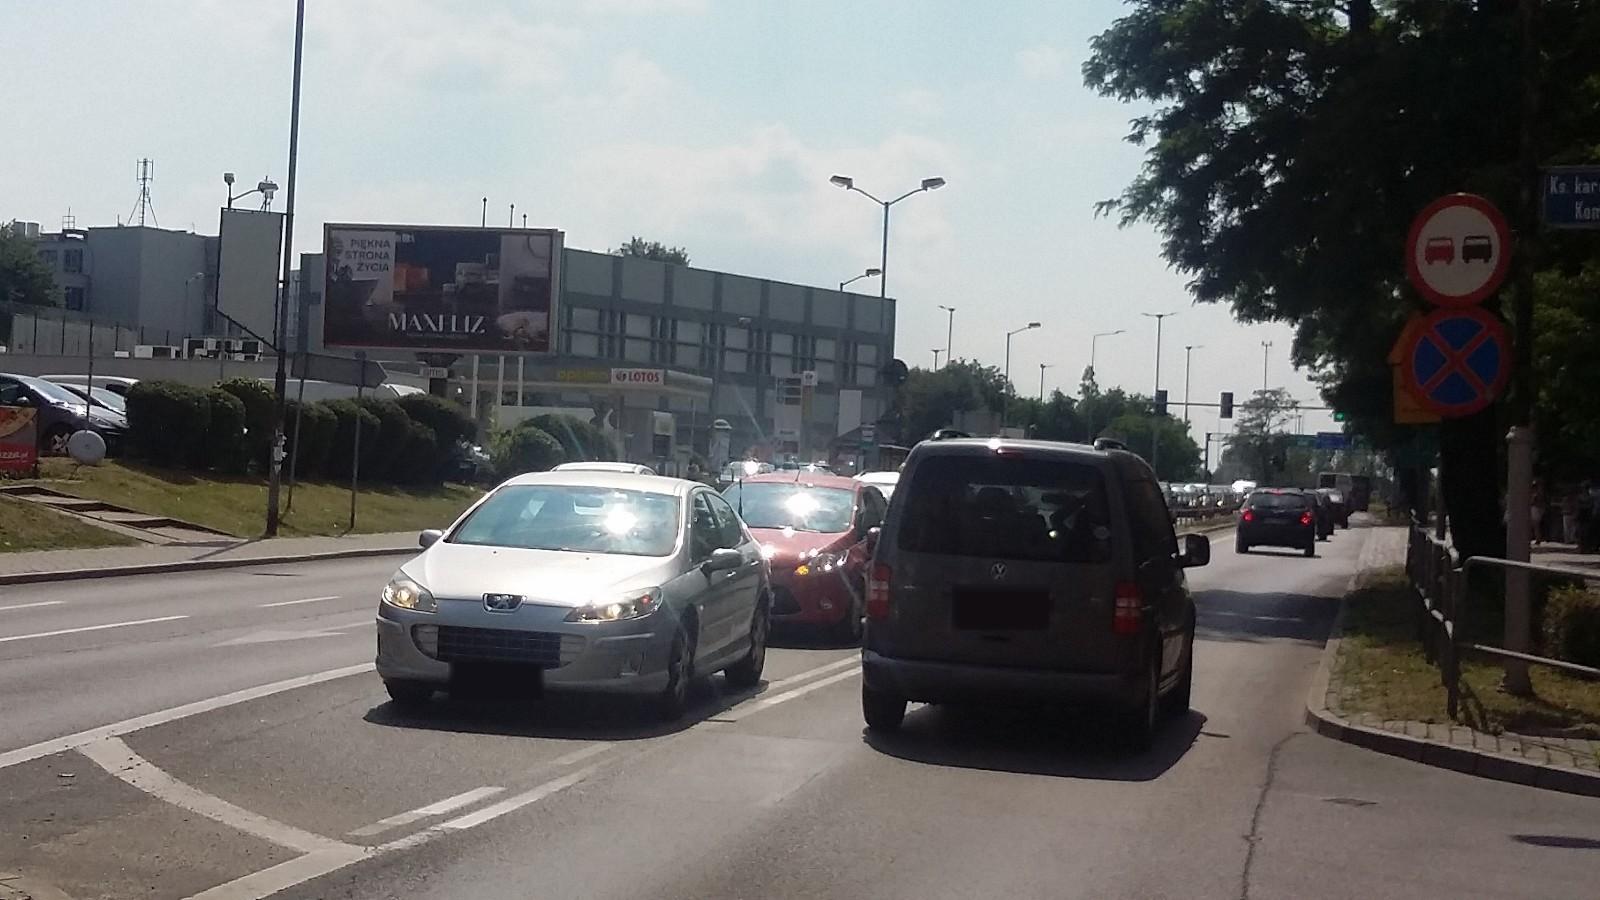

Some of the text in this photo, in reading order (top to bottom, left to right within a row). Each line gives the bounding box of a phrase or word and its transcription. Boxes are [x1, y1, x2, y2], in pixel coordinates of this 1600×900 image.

[1574, 176, 1600, 193] kar
[344, 250, 390, 259] STRONA
[629, 372, 660, 382] LOTOS
